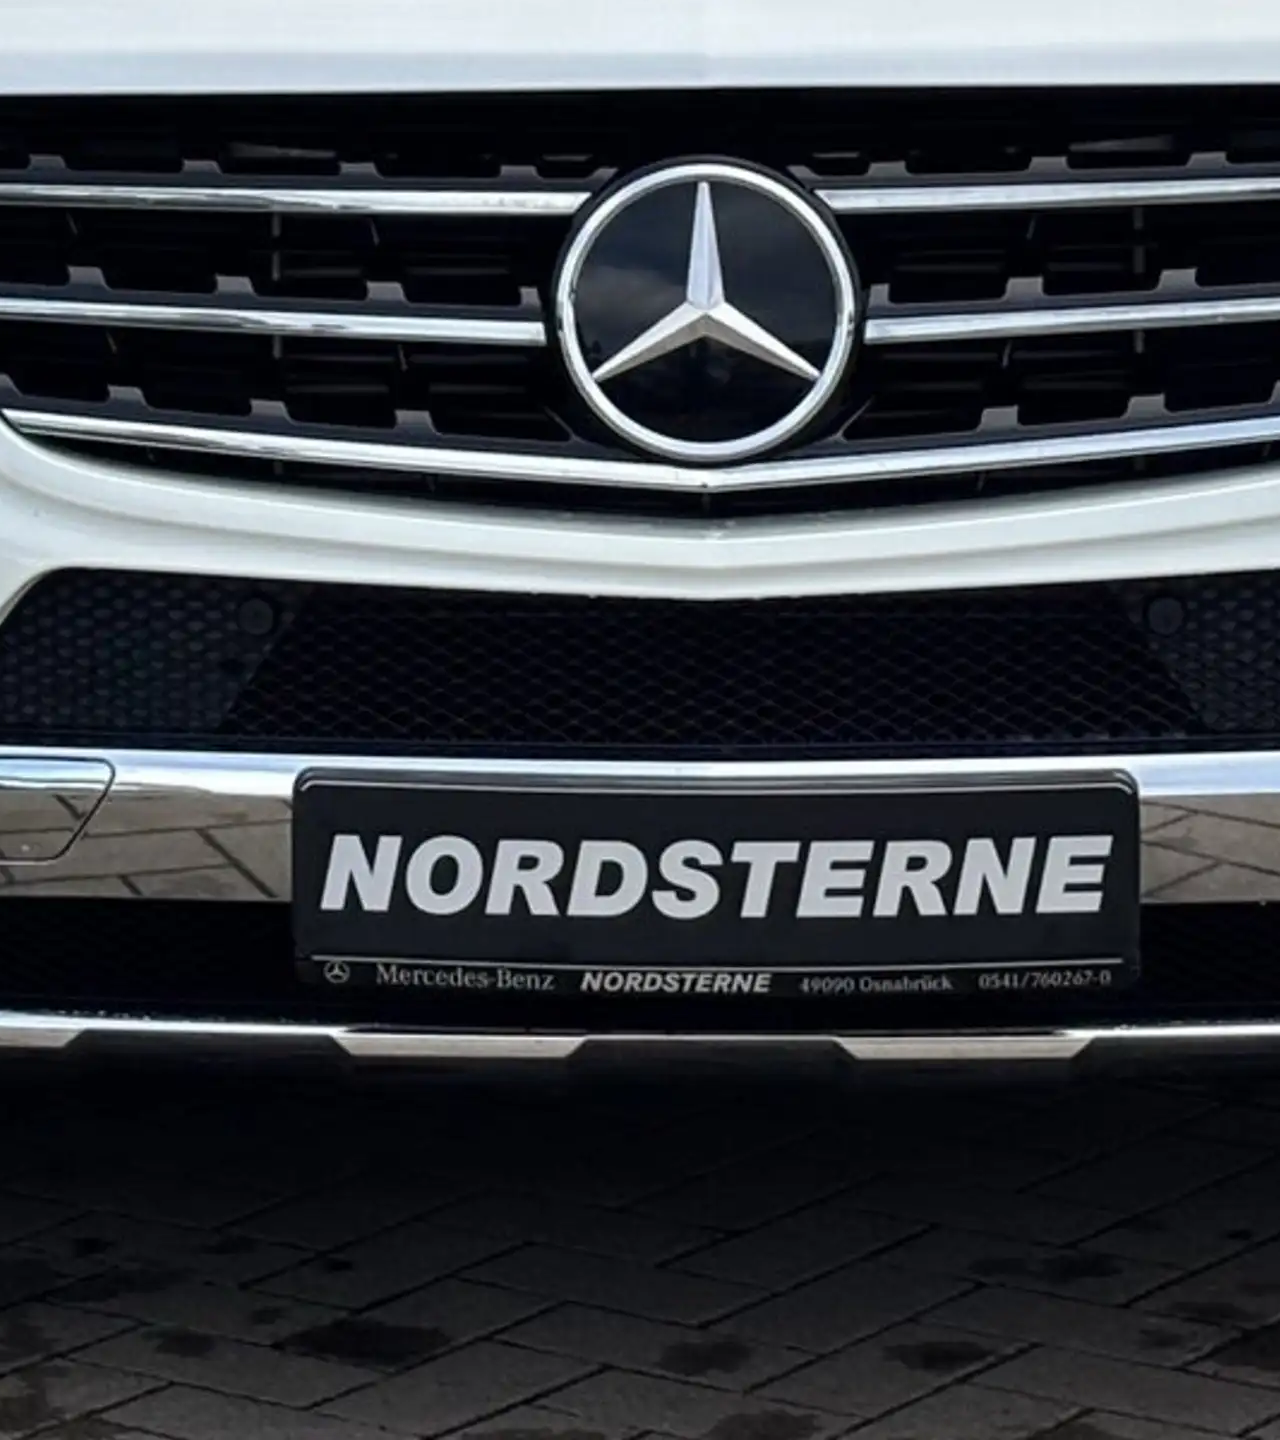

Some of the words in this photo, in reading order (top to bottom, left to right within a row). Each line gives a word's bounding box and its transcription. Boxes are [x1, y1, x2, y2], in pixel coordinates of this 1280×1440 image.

[320, 834, 1113, 919] NORDSTERNE
[376, 963, 555, 991] Mercedes-Benz
[580, 971, 772, 994] NORDSTERNE
[859, 972, 953, 993] Osnabrück
